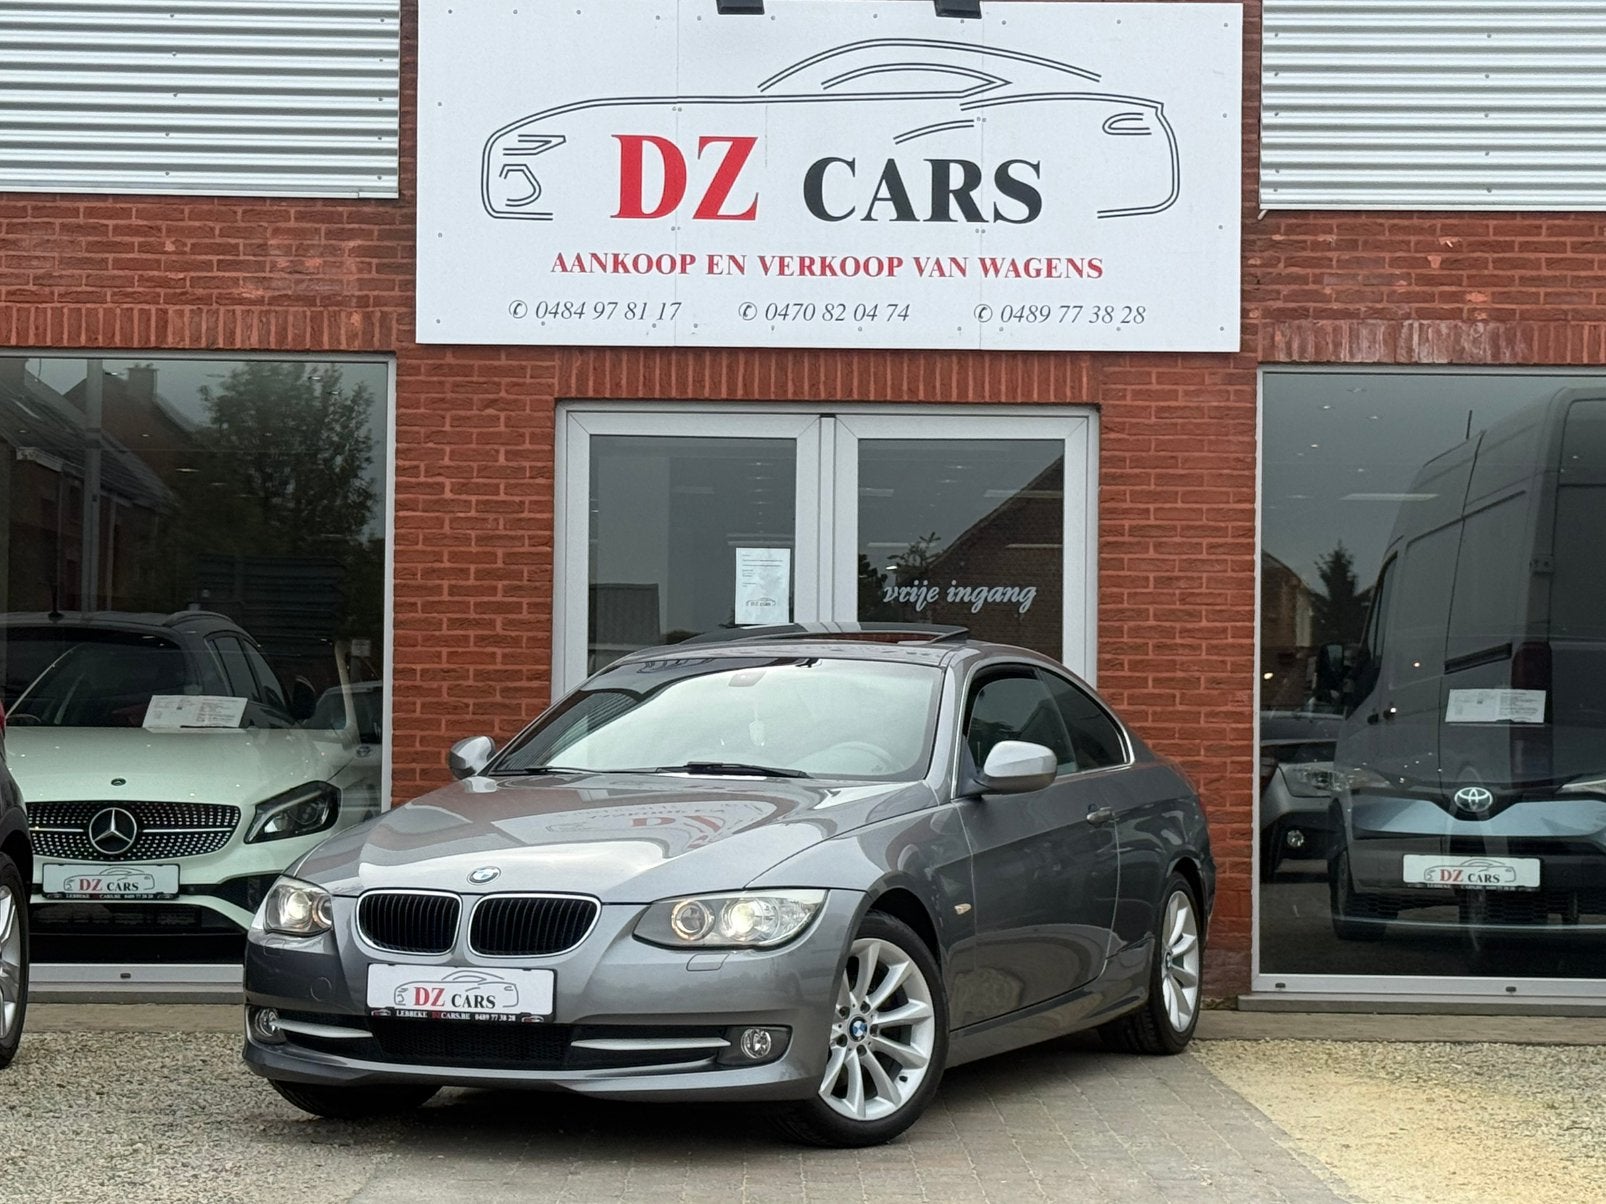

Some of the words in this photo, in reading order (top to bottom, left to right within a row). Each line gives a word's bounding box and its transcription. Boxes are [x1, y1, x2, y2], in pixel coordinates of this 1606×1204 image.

[610, 135, 758, 220] DZ
[804, 157, 1042, 224] CARS
[551, 253, 696, 275] AANKOOP
[706, 254, 747, 276] EN
[758, 255, 903, 277] VERKOOP
[914, 257, 968, 277] VAN
[979, 258, 1103, 279] WAGENS
[536, 301, 586, 320] 0484
[593, 301, 619, 320] 97
[624, 301, 648, 320] 81
[656, 302, 682, 321] 17
[765, 302, 816, 322] 0470
[822, 303, 847, 322] 82
[853, 303, 878, 322] 04
[886, 303, 910, 322] 74
[1000, 304, 1051, 323] 0489
[1058, 305, 1084, 324] 77
[1089, 305, 1115, 324] 38
[1120, 305, 1146, 324] 28
[883, 580, 940, 612] vrije
[947, 580, 1037, 614] ingang
[79, 878, 102, 891] DZ
[106, 881, 139, 892] CARS
[1440, 869, 1464, 882] DZ
[1467, 873, 1500, 883] CARS
[414, 986, 446, 1007] DZ
[451, 993, 496, 1009] CARS
